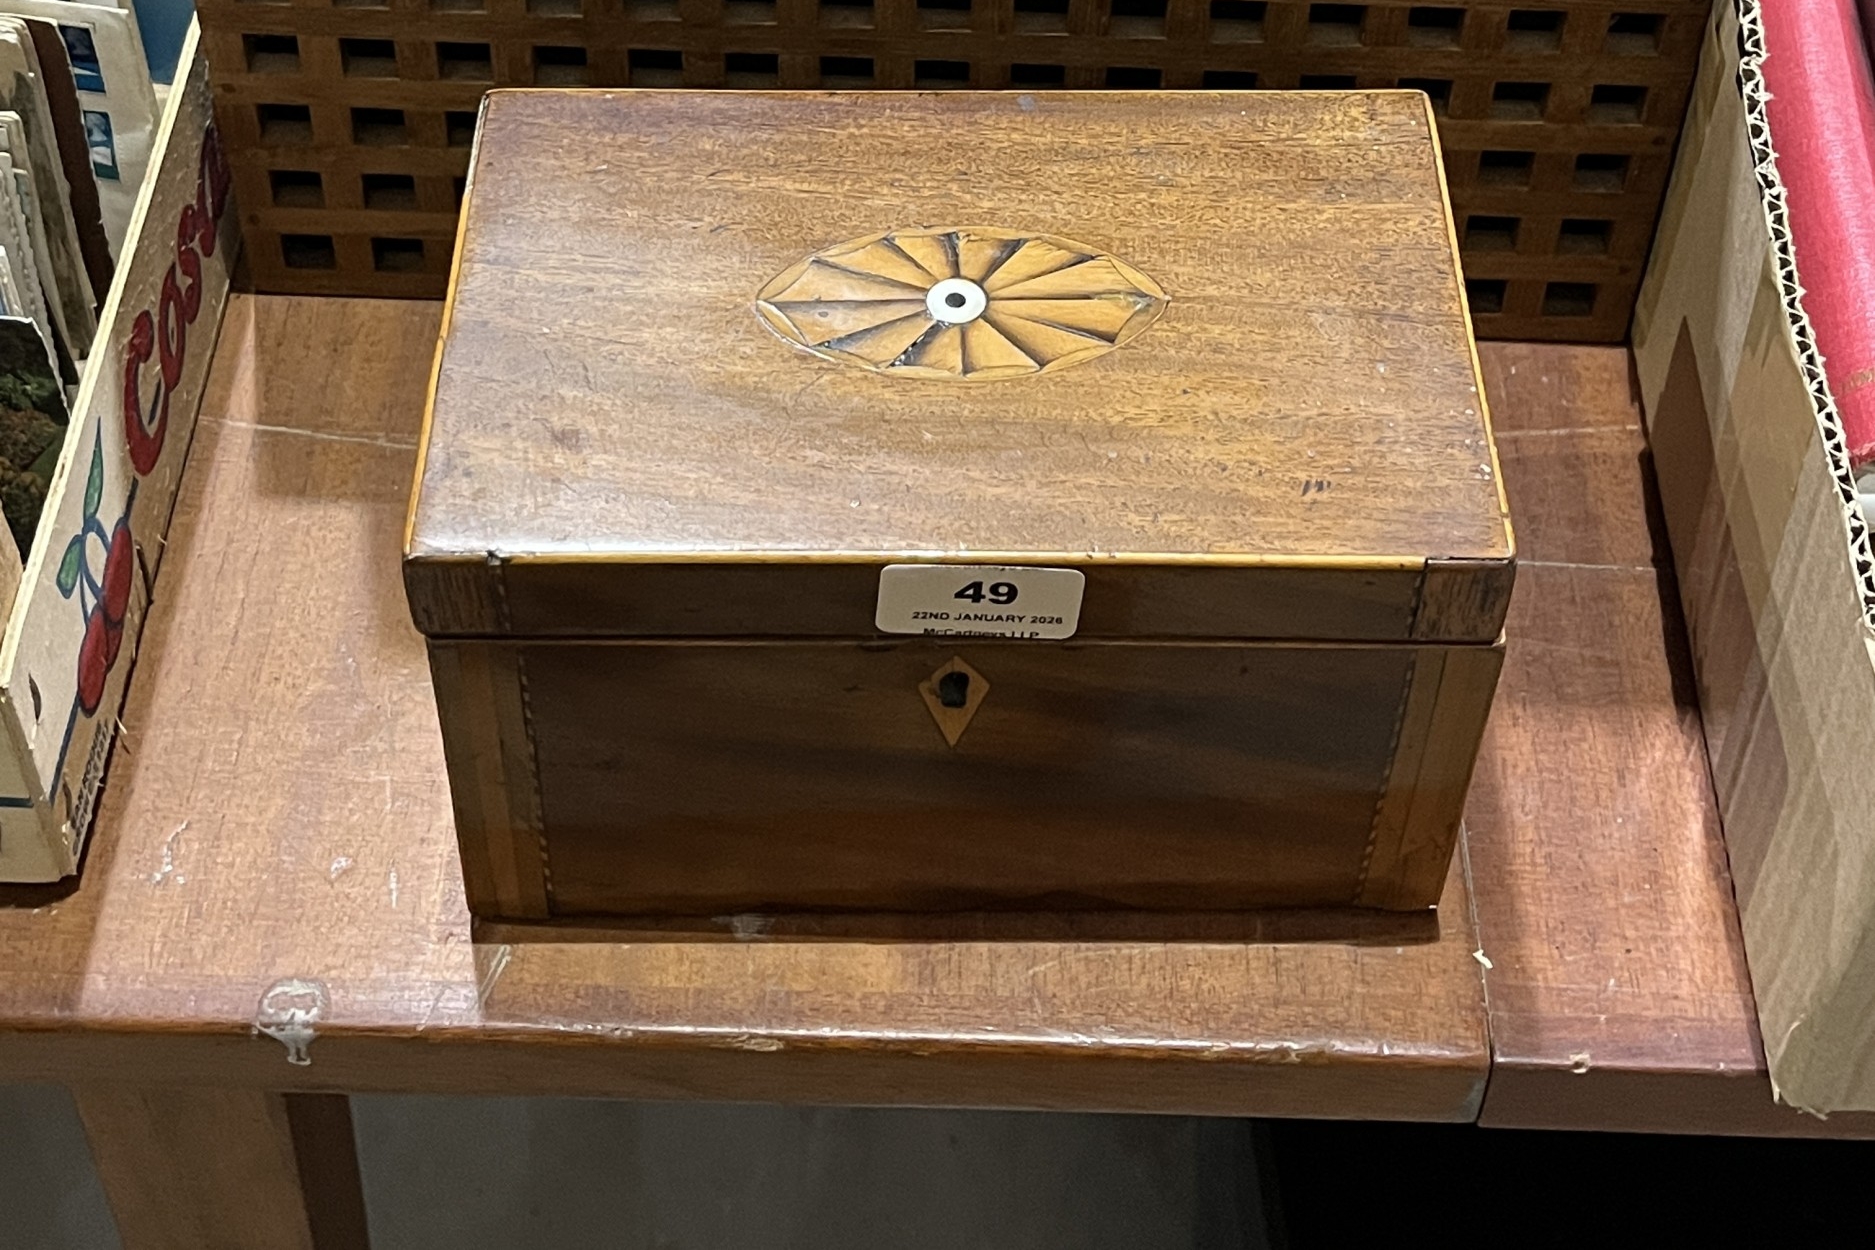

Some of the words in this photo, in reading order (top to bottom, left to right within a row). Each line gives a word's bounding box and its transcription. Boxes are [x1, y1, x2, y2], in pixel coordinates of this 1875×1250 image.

[954, 581, 1019, 605] 49
[911, 611, 950, 621] 22ND
[953, 612, 1026, 624] JANUARY
[1030, 615, 1063, 625] 2026
